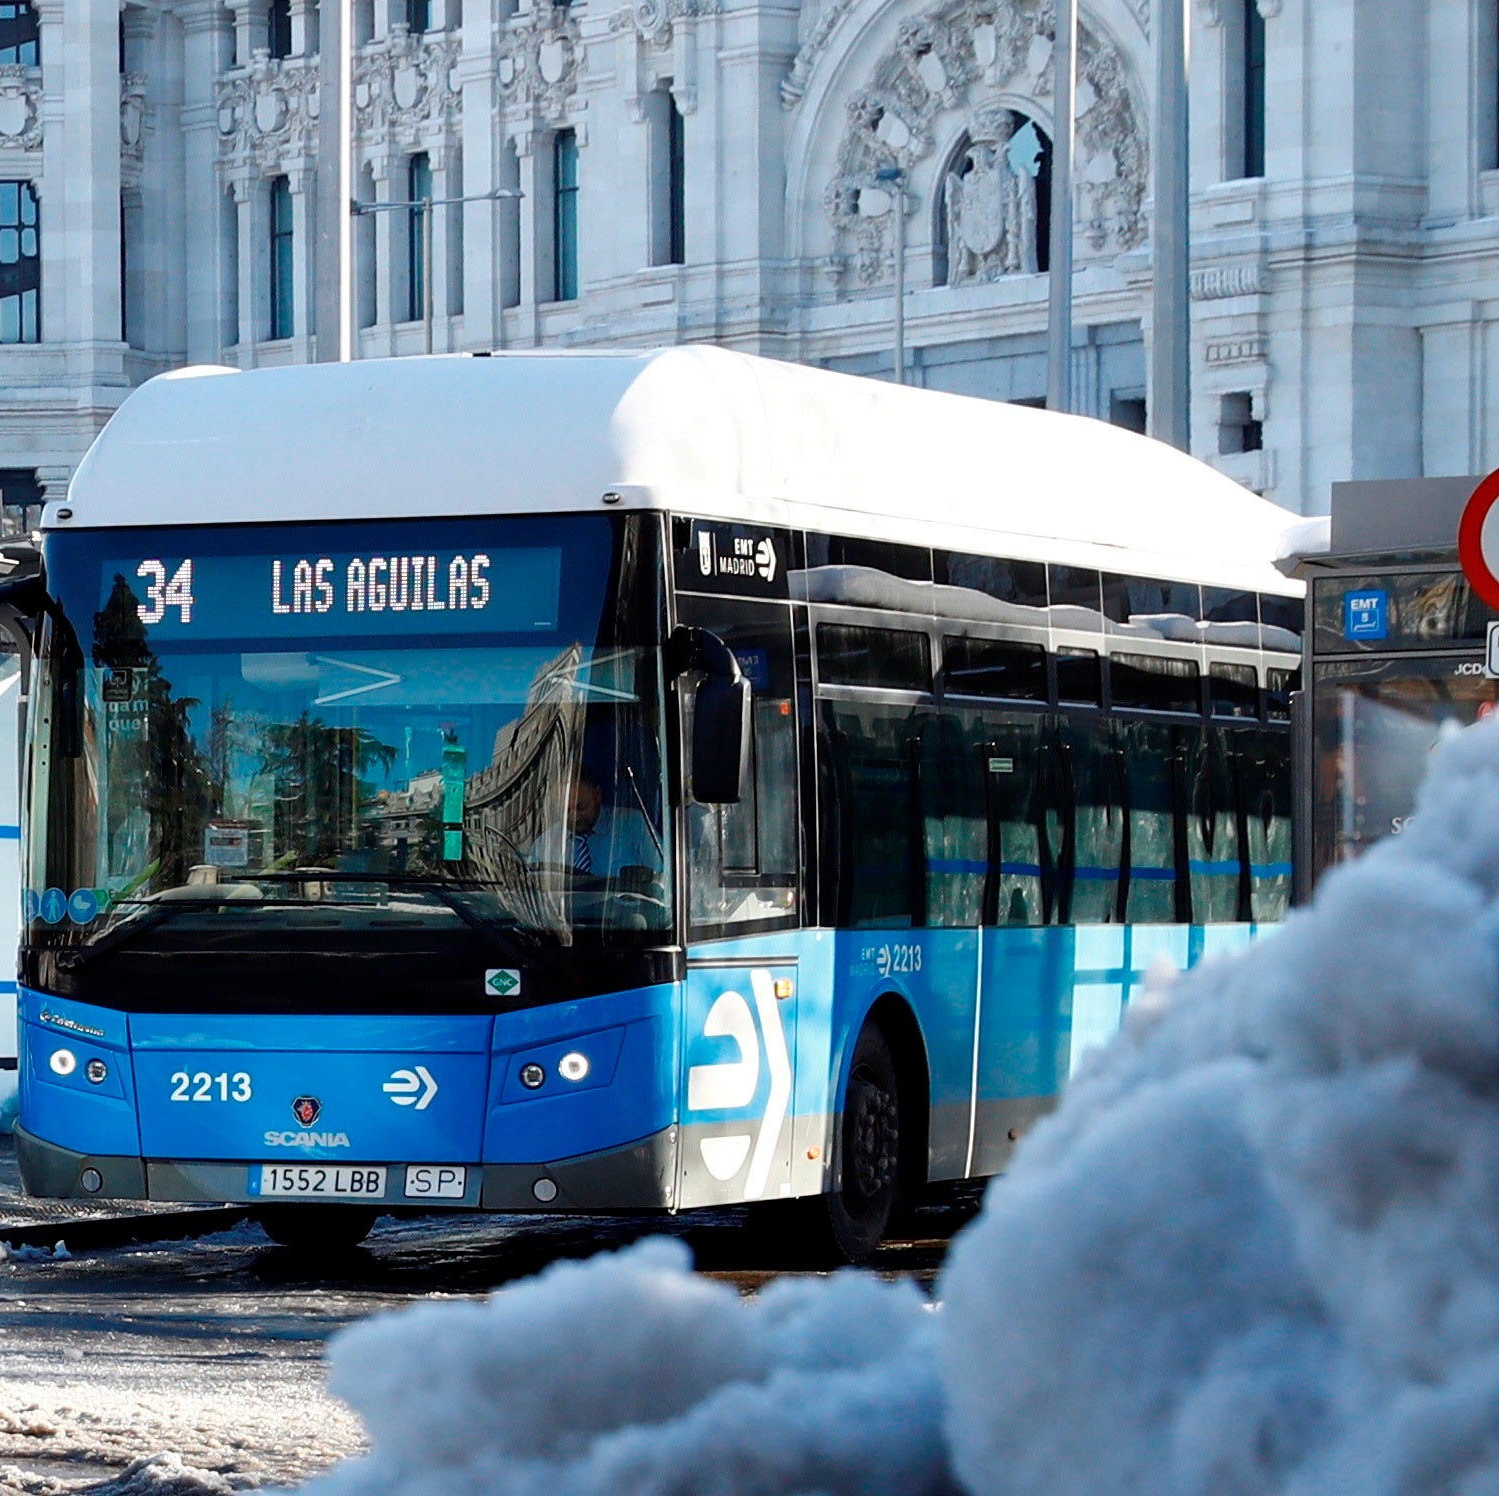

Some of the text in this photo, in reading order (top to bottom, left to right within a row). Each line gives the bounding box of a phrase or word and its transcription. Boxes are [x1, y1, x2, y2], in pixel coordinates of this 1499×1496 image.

[734, 538, 754, 556] EMT
[719, 557, 755, 577] MADRID
[136, 554, 490, 625] 34 LAS AGUILAS
[1350, 598, 1379, 611] EMT
[893, 944, 922, 973] 2213
[492, 978, 514, 987] GNC
[170, 1071, 252, 1102] 2213
[264, 1131, 350, 1147] SCANIA
[270, 1168, 380, 1193] 1552 LBB
[415, 1169, 456, 1193] SP
